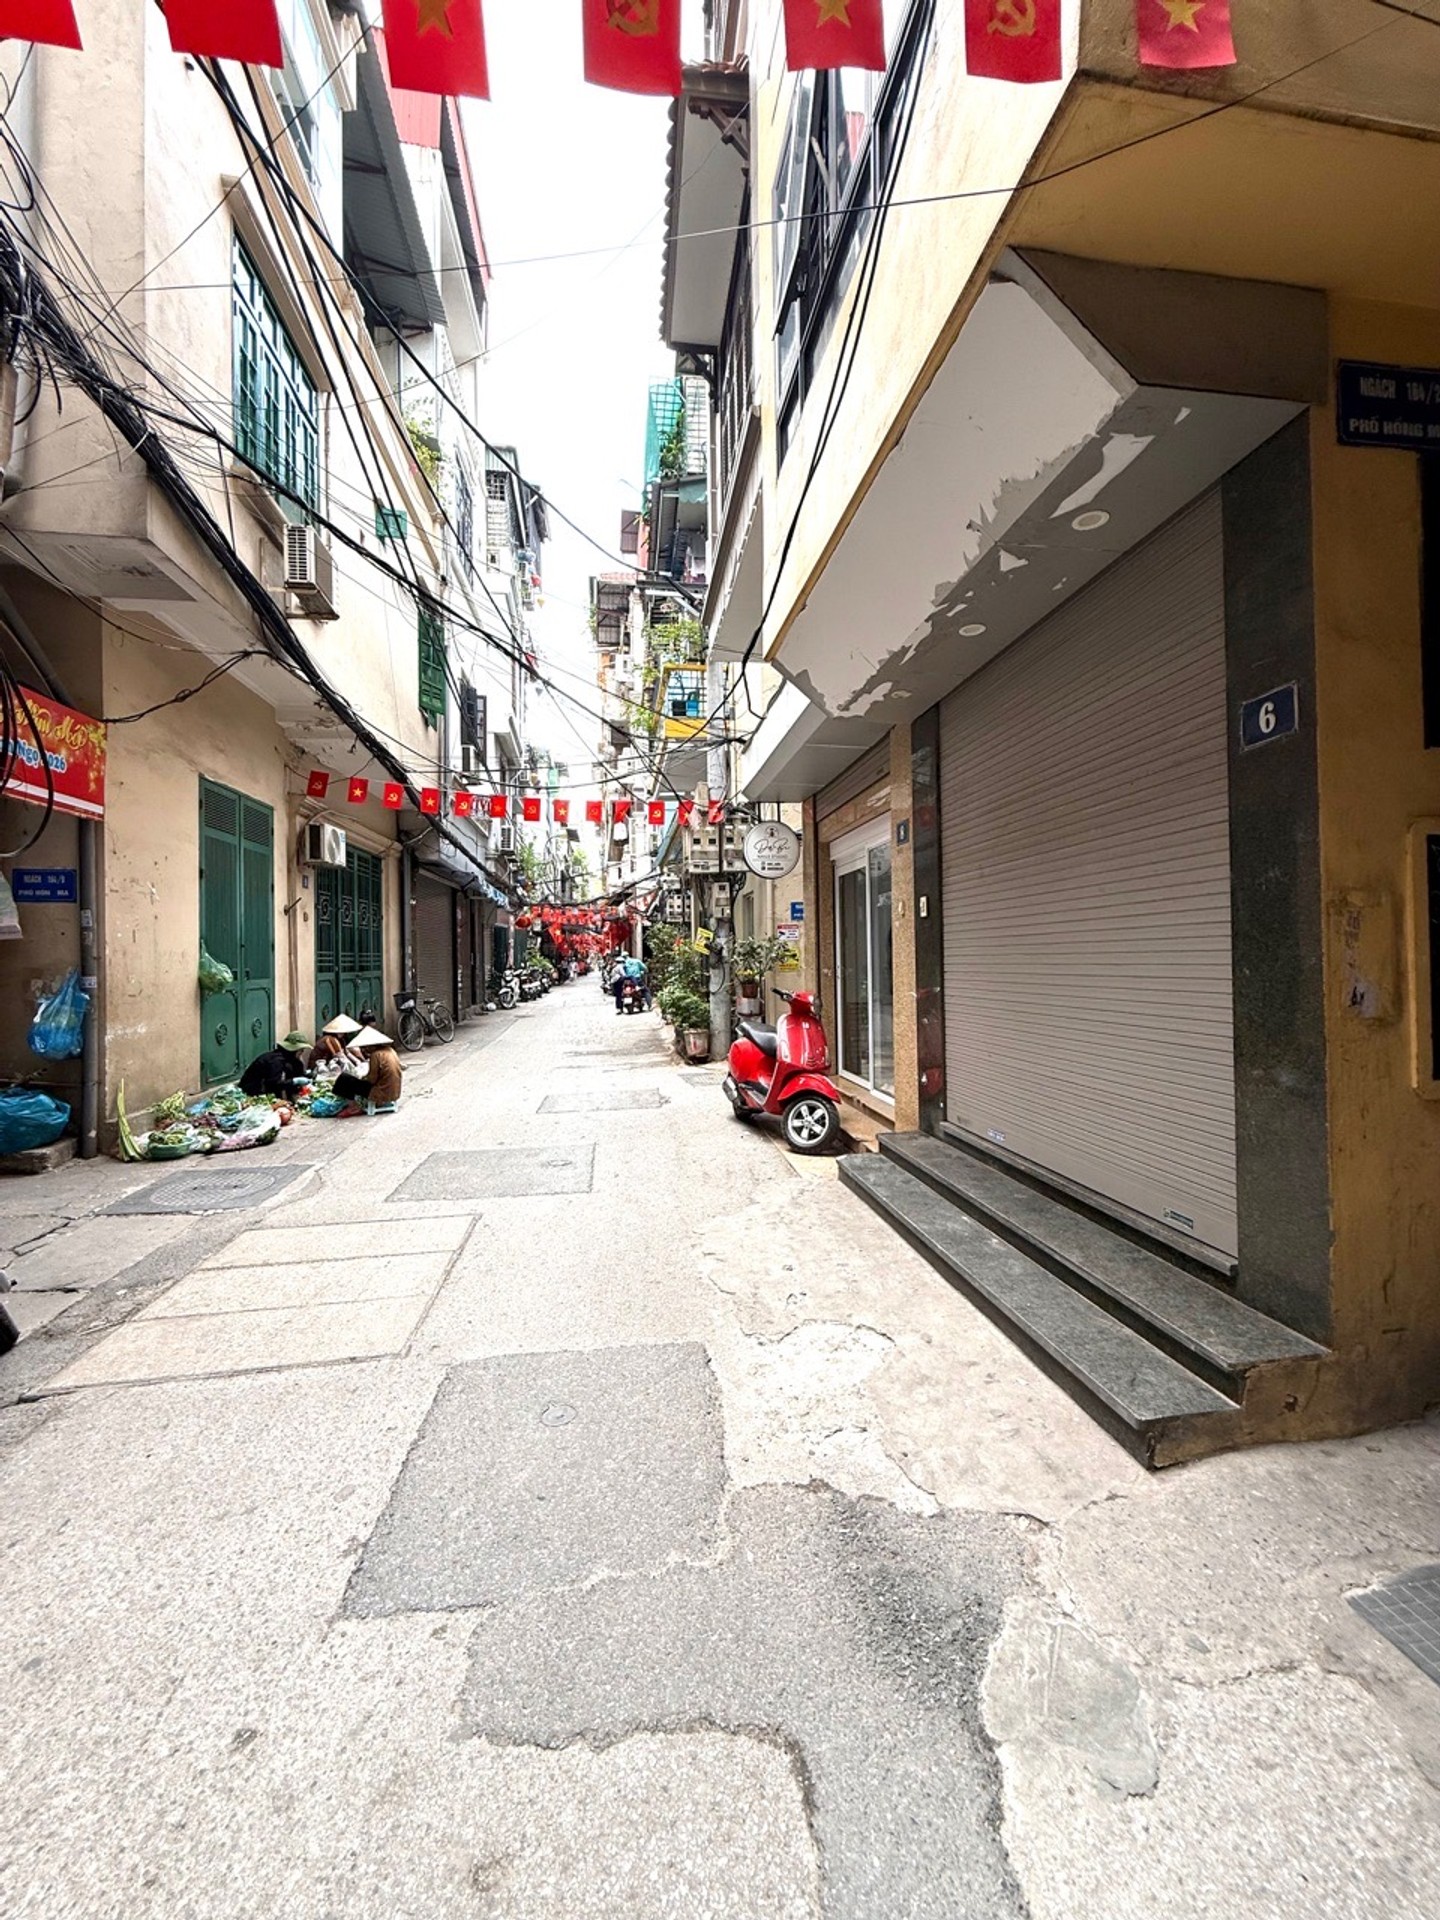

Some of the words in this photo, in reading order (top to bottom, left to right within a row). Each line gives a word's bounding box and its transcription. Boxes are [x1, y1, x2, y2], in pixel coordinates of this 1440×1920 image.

[1360, 373, 1397, 400] NGÁCH
[1348, 415, 1379, 434] PHỐ
[1258, 701, 1276, 734] 6
[42, 752, 67, 773] 026
